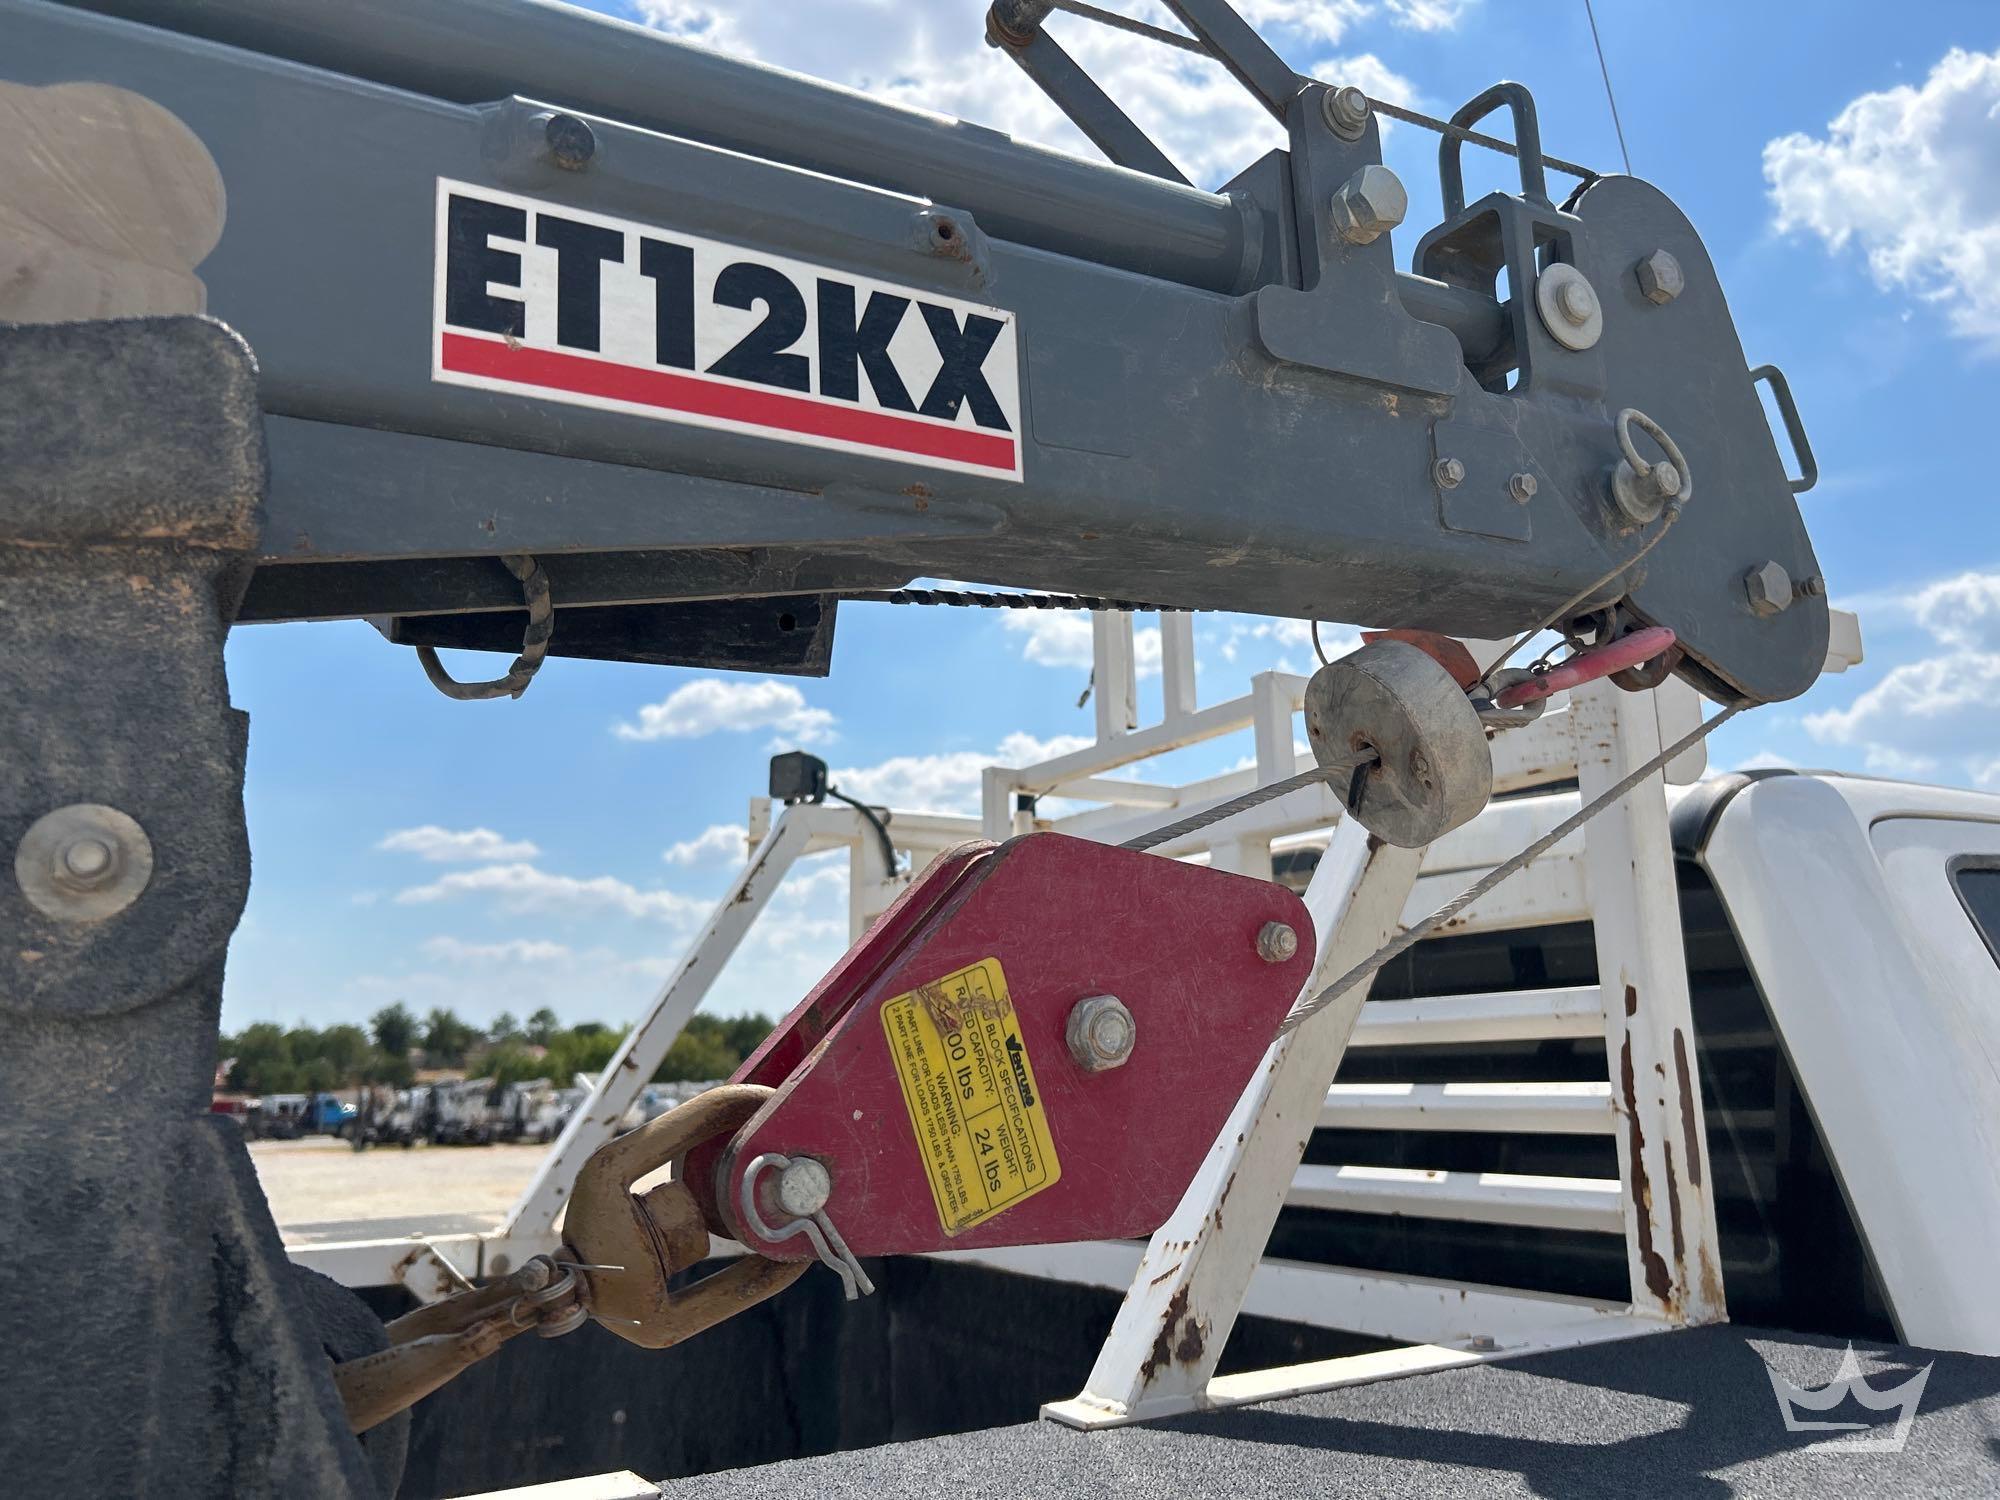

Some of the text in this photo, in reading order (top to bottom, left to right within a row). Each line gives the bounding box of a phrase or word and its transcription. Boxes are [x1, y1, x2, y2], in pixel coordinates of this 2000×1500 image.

[445, 193, 1012, 432] ET12KX
[894, 1013, 908, 1038] PART
[905, 1008, 918, 1033] PART
[901, 1038, 915, 1062] LINE
[912, 1034, 924, 1057] LINE
[908, 1061, 920, 1083] FOR
[919, 1056, 931, 1078] FOR
[970, 1030, 993, 1097] CAPACITY:
[1005, 1032, 1034, 1108] VENTURO
[925, 1078, 941, 1111] LOADS
[956, 1064, 974, 1099] lbs
[914, 1083, 930, 1116] LOADS
[935, 1071, 960, 1138] WARNING:
[984, 1022, 1006, 1067] BLOCK
[999, 1068, 1036, 1173] SPECIFICATIONS
[925, 1117, 936, 1138] 1750
[935, 1111, 948, 1136] LESS
[931, 1138, 942, 1160] LBS.
[943, 1135, 955, 1163] THAN
[974, 1127, 1000, 1191] 24 lbs
[996, 1123, 1017, 1178] WEIGHT:
[937, 1160, 946, 1169] &
[951, 1163, 962, 1185] 1750
[940, 1169, 959, 1214] GREATER
[956, 1185, 968, 1206] LBS.
